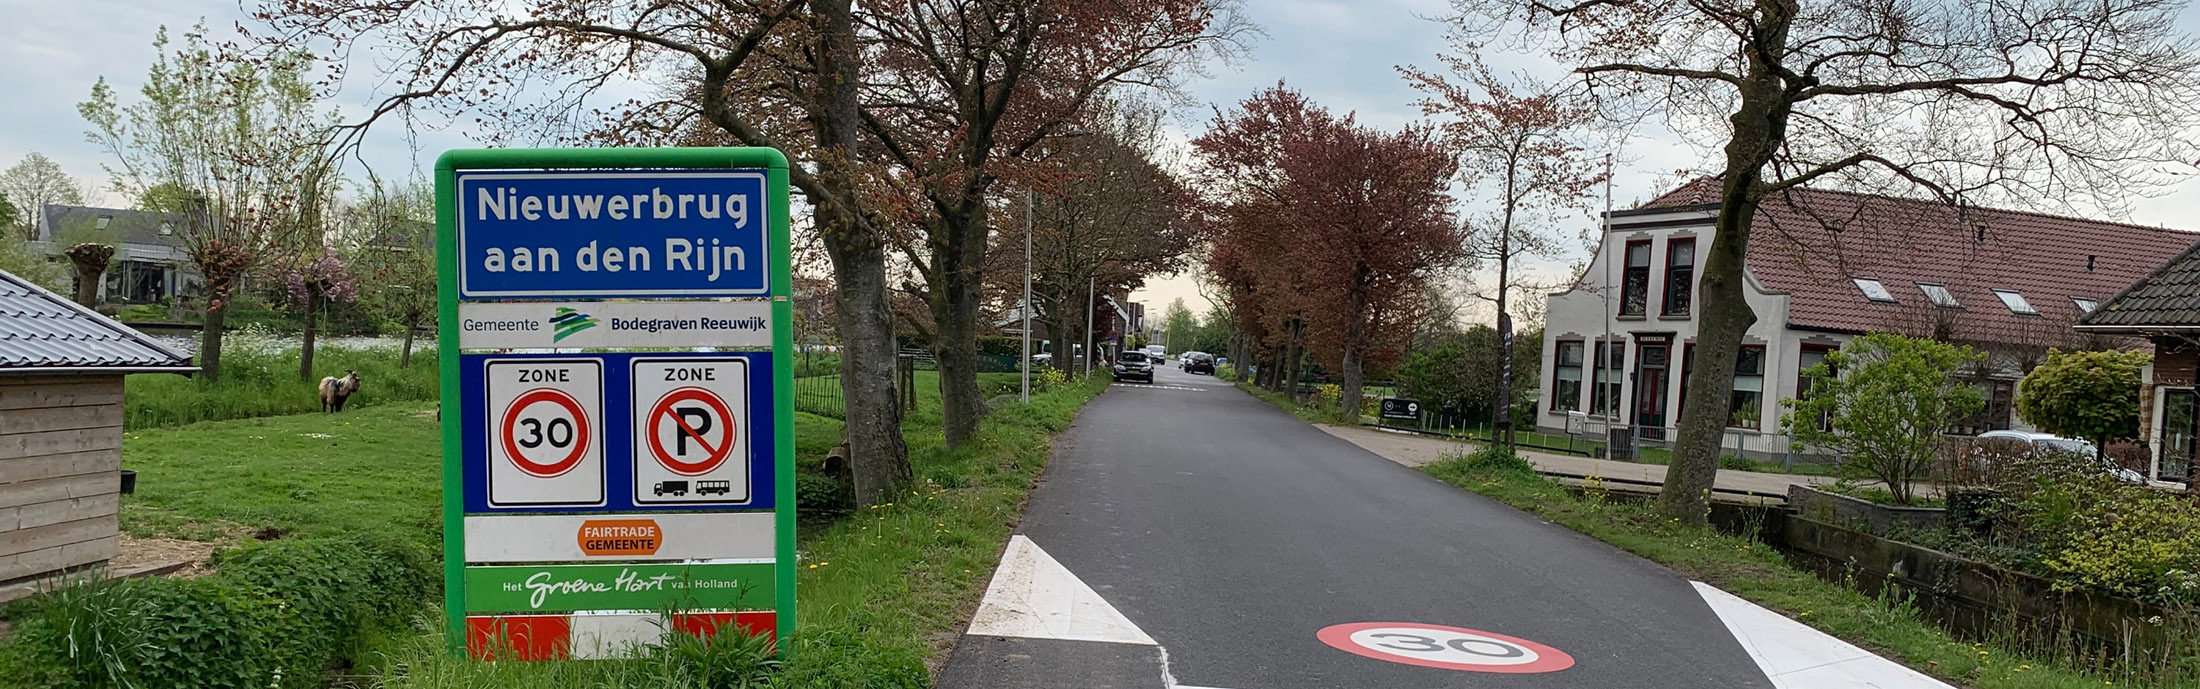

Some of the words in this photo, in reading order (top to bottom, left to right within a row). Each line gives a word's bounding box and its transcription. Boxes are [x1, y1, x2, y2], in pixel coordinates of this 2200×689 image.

[479, 187, 748, 230] Nieuwerbrug
[484, 246, 560, 273] aan
[576, 240, 651, 272] den
[666, 238, 745, 282] Rijn
[463, 318, 539, 332] Gemeente
[611, 317, 698, 334] Bodegraven
[700, 316, 767, 332] Reeuwijk
[518, 368, 570, 383] ZONE
[664, 367, 716, 382] ZONE
[518, 417, 573, 449] 30
[676, 406, 712, 457] P
[584, 526, 655, 539] FAIRTRADE
[585, 540, 655, 551] GEMEENTE
[503, 582, 522, 592] Het
[525, 571, 612, 609] Groene
[615, 568, 676, 592] Hart
[694, 579, 738, 589] Holland
[1370, 633, 1524, 658] 30
